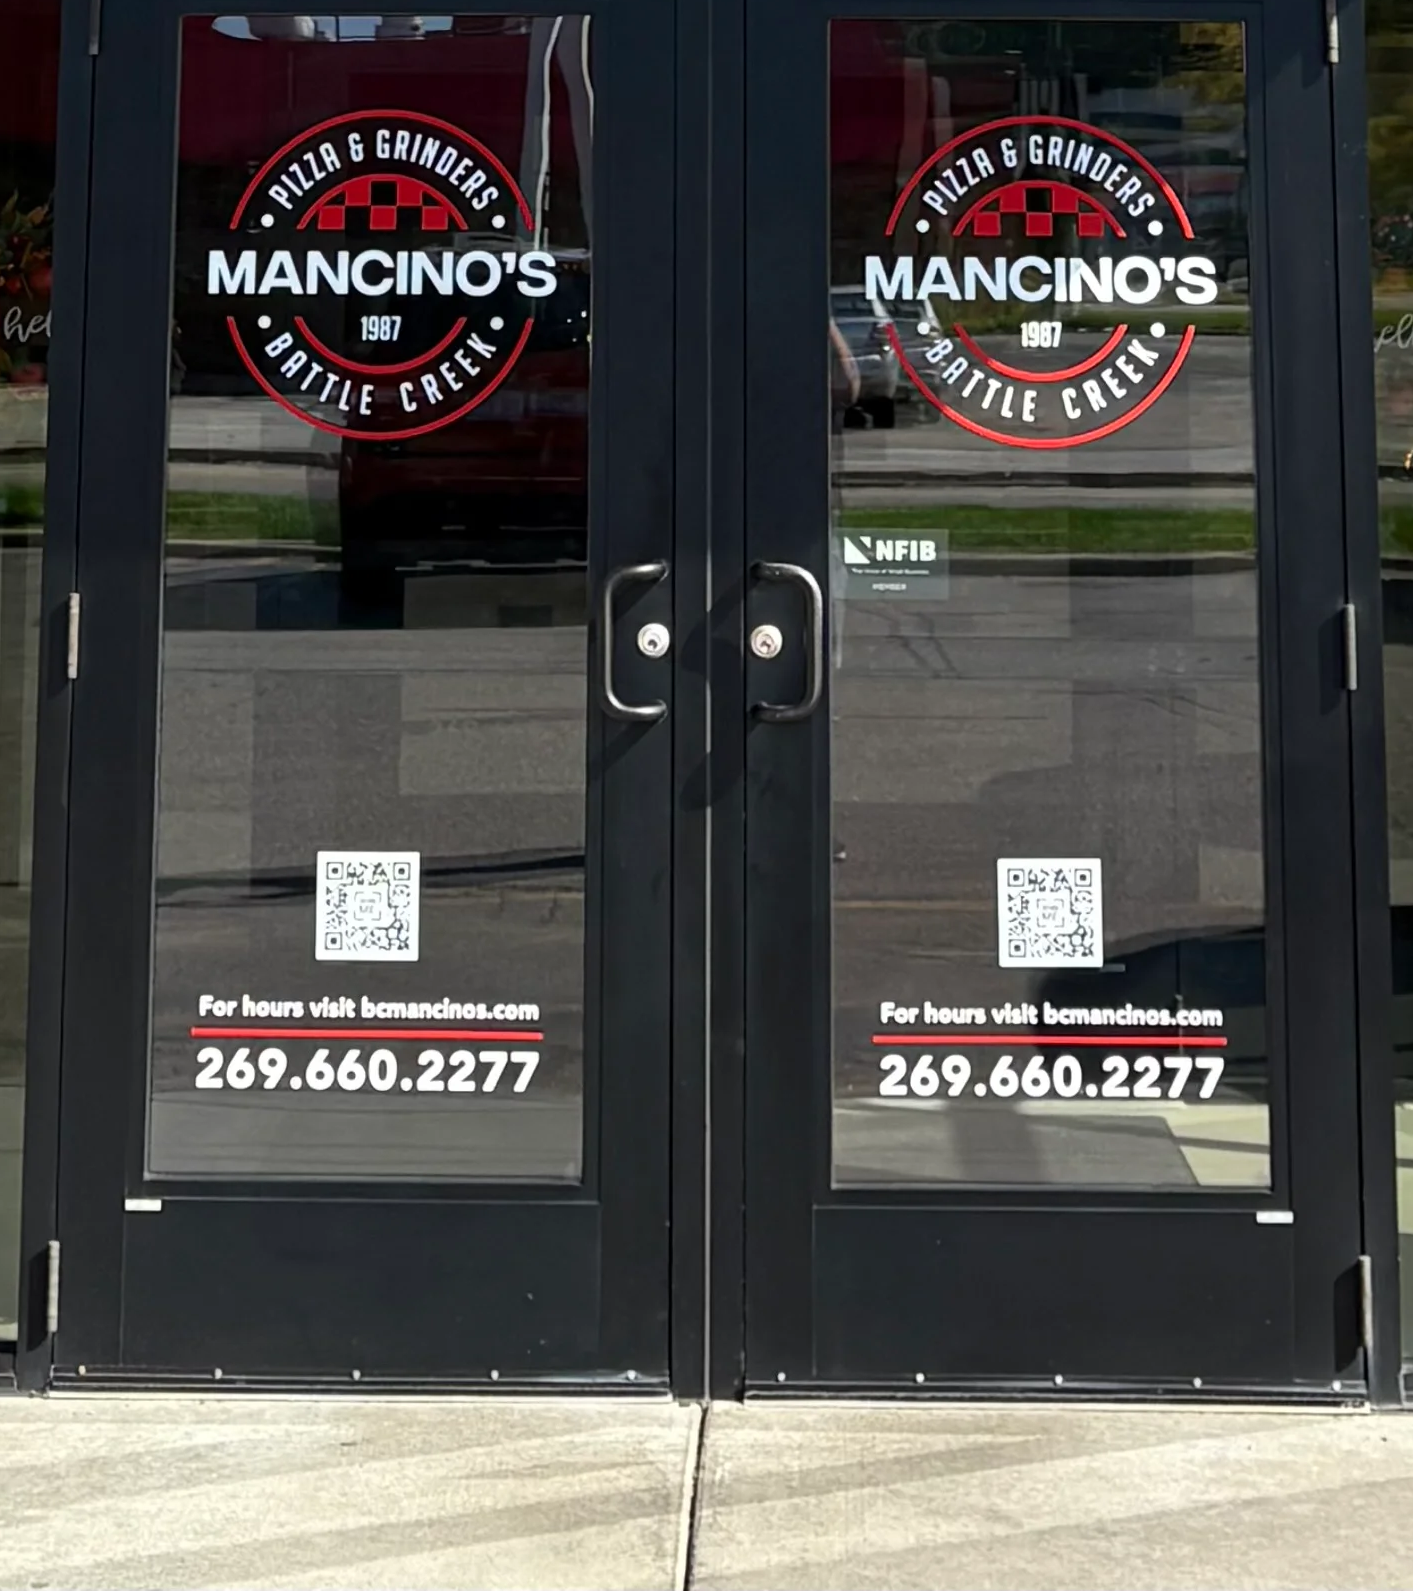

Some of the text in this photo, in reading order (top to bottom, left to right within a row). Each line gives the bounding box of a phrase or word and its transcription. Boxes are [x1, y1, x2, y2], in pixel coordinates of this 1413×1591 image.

[268, 129, 499, 211] PIZZA & GRINDERS
[922, 134, 1156, 217] PIZZA & GRINDERS
[207, 249, 558, 297] MANCINO'S
[864, 255, 1219, 305] MANCINO'S
[360, 315, 402, 342] 1987
[1020, 320, 1063, 349] 1987
[264, 332, 498, 416] BATTLE CREEK
[924, 337, 1160, 423] BATTLE CREEK
[875, 539, 937, 562] NFIB
[198, 993, 540, 1021] For hours visit bcmancinos.com
[880, 1000, 1224, 1027] For hours visit bcmancinos.com
[194, 1046, 541, 1093] 269.660.2277
[878, 1053, 1225, 1099] 269.660.2277
